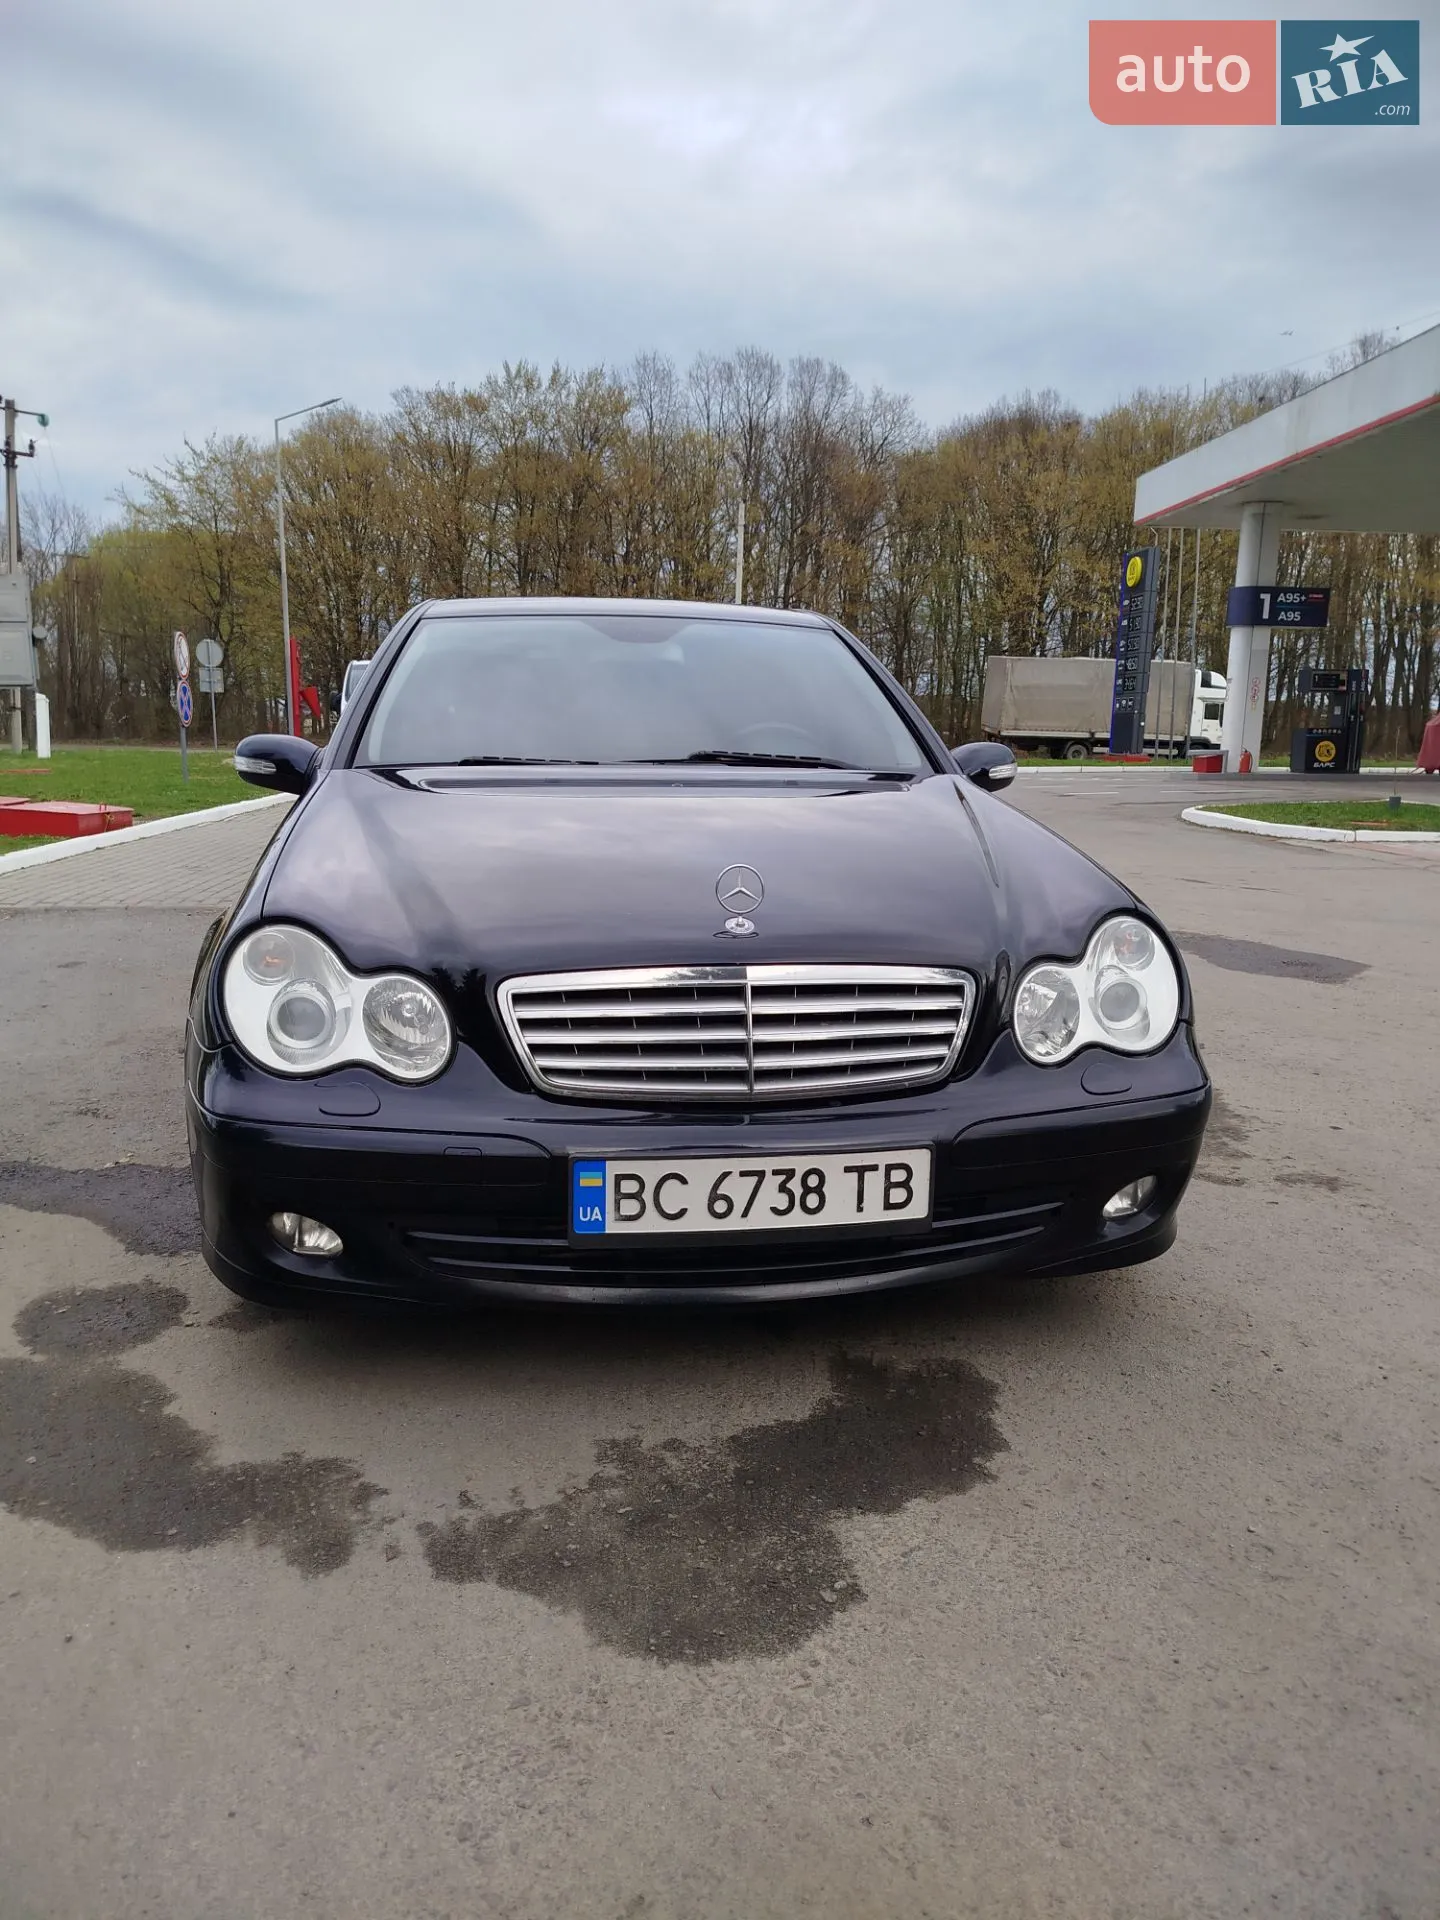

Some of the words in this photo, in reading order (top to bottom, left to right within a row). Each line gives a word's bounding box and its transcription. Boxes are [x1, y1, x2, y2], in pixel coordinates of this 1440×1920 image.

[1260, 593, 1271, 619] 1
[1277, 593, 1306, 603] A95+
[1277, 611, 1301, 621] A95
[613, 1172, 689, 1222] BC
[706, 1168, 827, 1220] 6738
[843, 1162, 914, 1213] TB
[579, 1206, 602, 1222] UA
